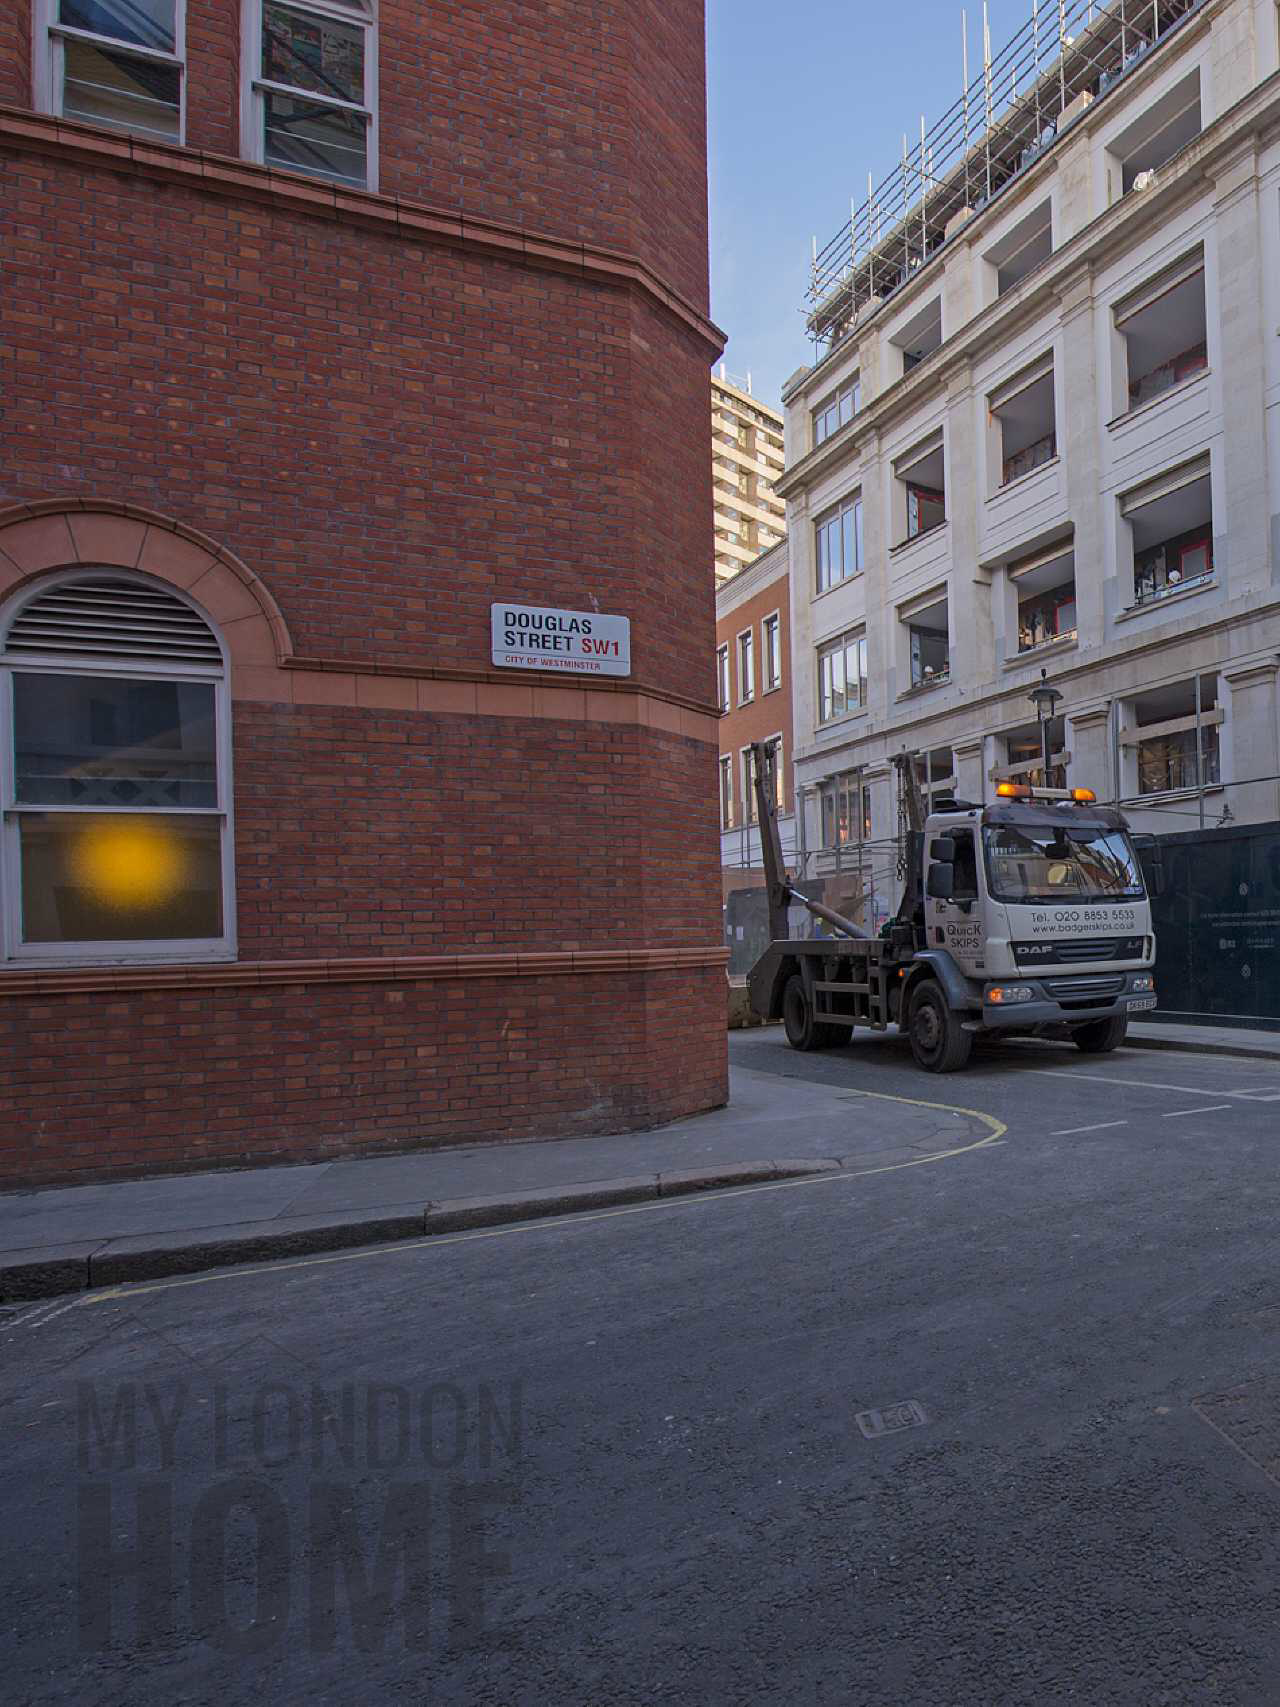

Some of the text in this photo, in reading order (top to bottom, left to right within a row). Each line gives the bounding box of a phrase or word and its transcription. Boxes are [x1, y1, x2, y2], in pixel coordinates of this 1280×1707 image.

[504, 610, 592, 634] DOUGLAS
[504, 631, 619, 656] STREET SW1
[527, 657, 537, 665] OF
[540, 659, 601, 671] WESTMINSTER
[1032, 912, 1050, 922] Tel.
[1055, 911, 1080, 922] 020
[951, 938, 979, 948] SKIPS
[1016, 945, 1053, 954] DAF
